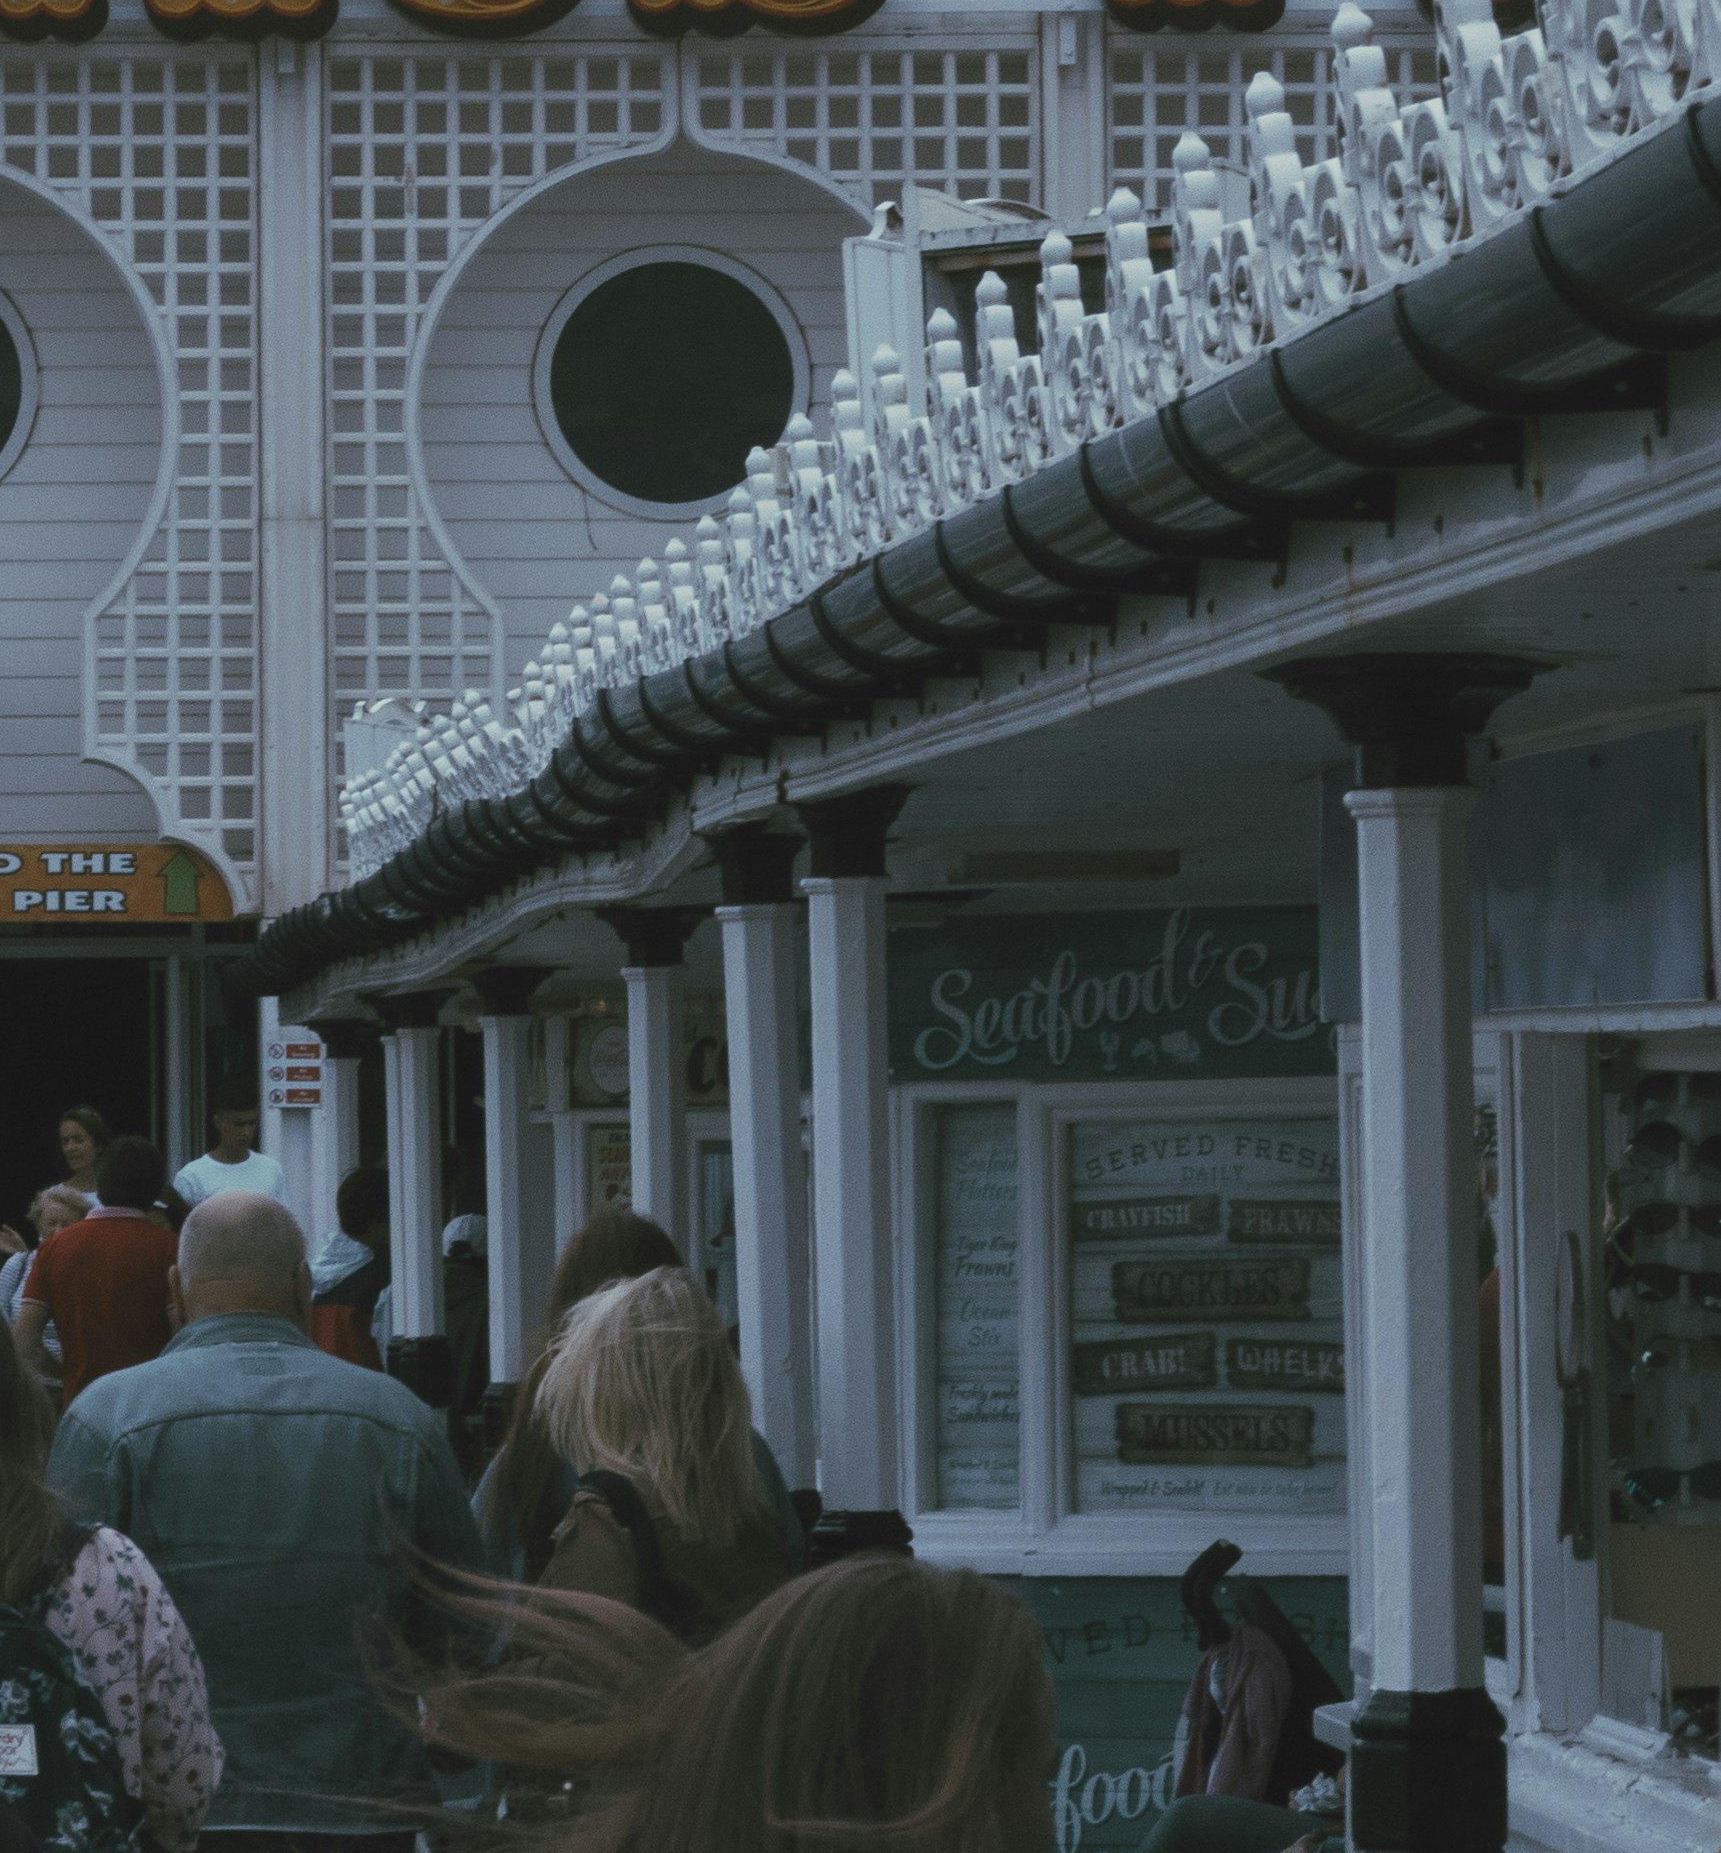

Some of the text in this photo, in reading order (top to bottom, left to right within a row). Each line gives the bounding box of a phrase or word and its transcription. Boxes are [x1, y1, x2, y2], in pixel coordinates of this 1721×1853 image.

[40, 852, 136, 875] THE
[14, 890, 126, 913] PIER
[914, 906, 1191, 1071] Seafood
[1207, 942, 1320, 1046] Su
[1083, 1134, 1340, 1180] SERVED FRESH
[1182, 1165, 1245, 1182] DAILY
[1086, 1203, 1192, 1230] CRAYFISH
[1139, 1268, 1281, 1307] COCKLES
[1141, 1413, 1291, 1452] MUSSELS
